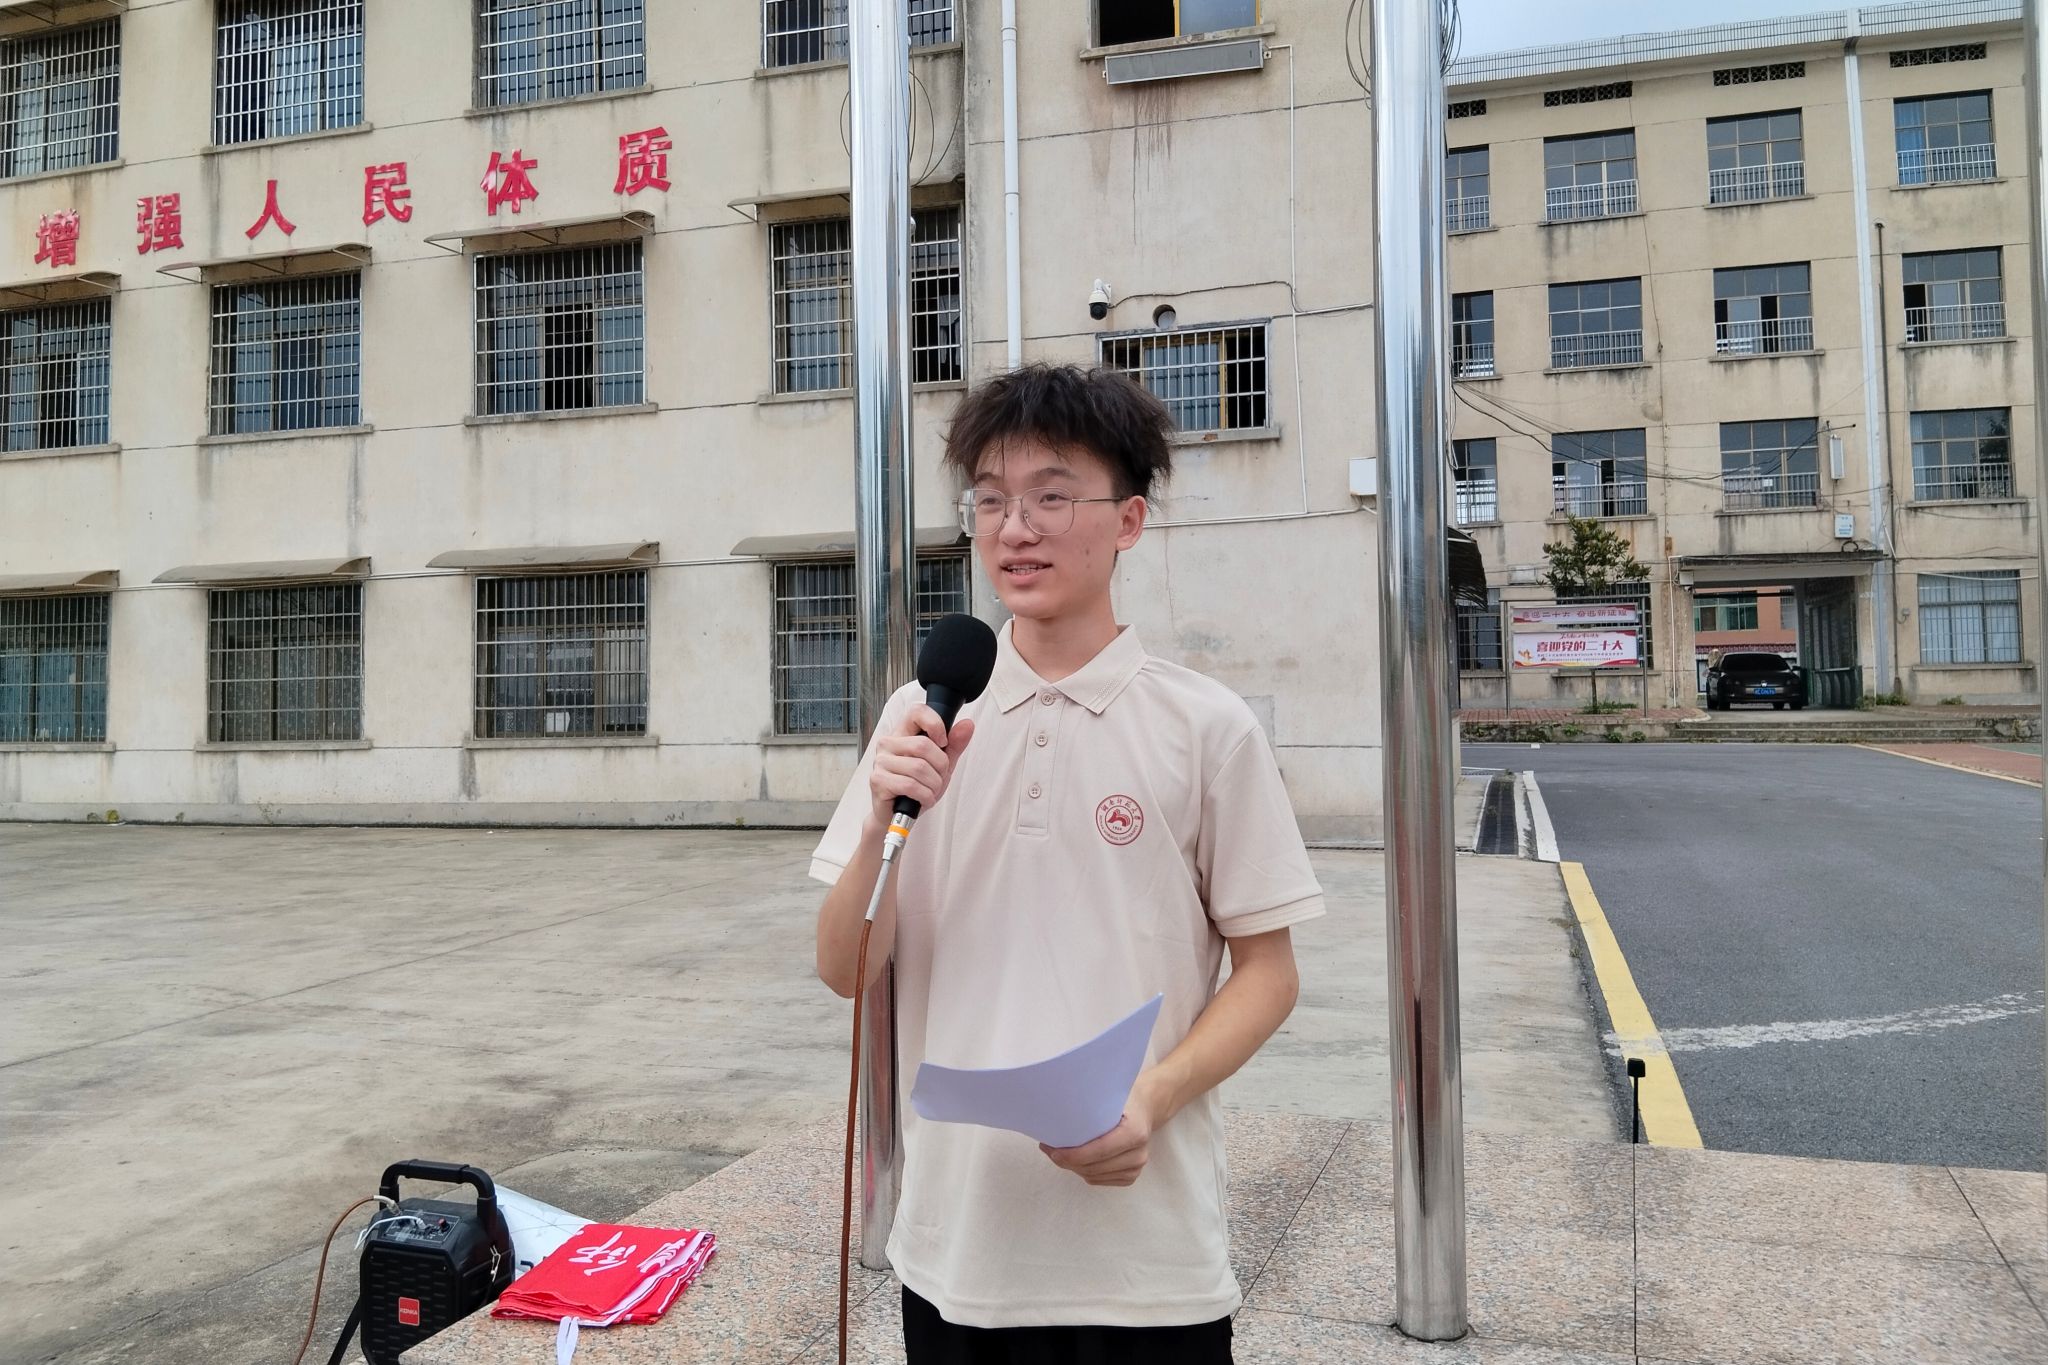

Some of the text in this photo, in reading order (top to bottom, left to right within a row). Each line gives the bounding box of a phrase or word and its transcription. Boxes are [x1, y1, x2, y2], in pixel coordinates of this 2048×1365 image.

[34, 126, 672, 268] 增强人民体质
[1522, 610, 1570, 619] 喜迎二十大
[1536, 640, 1623, 652] 喜迎党的二十大
